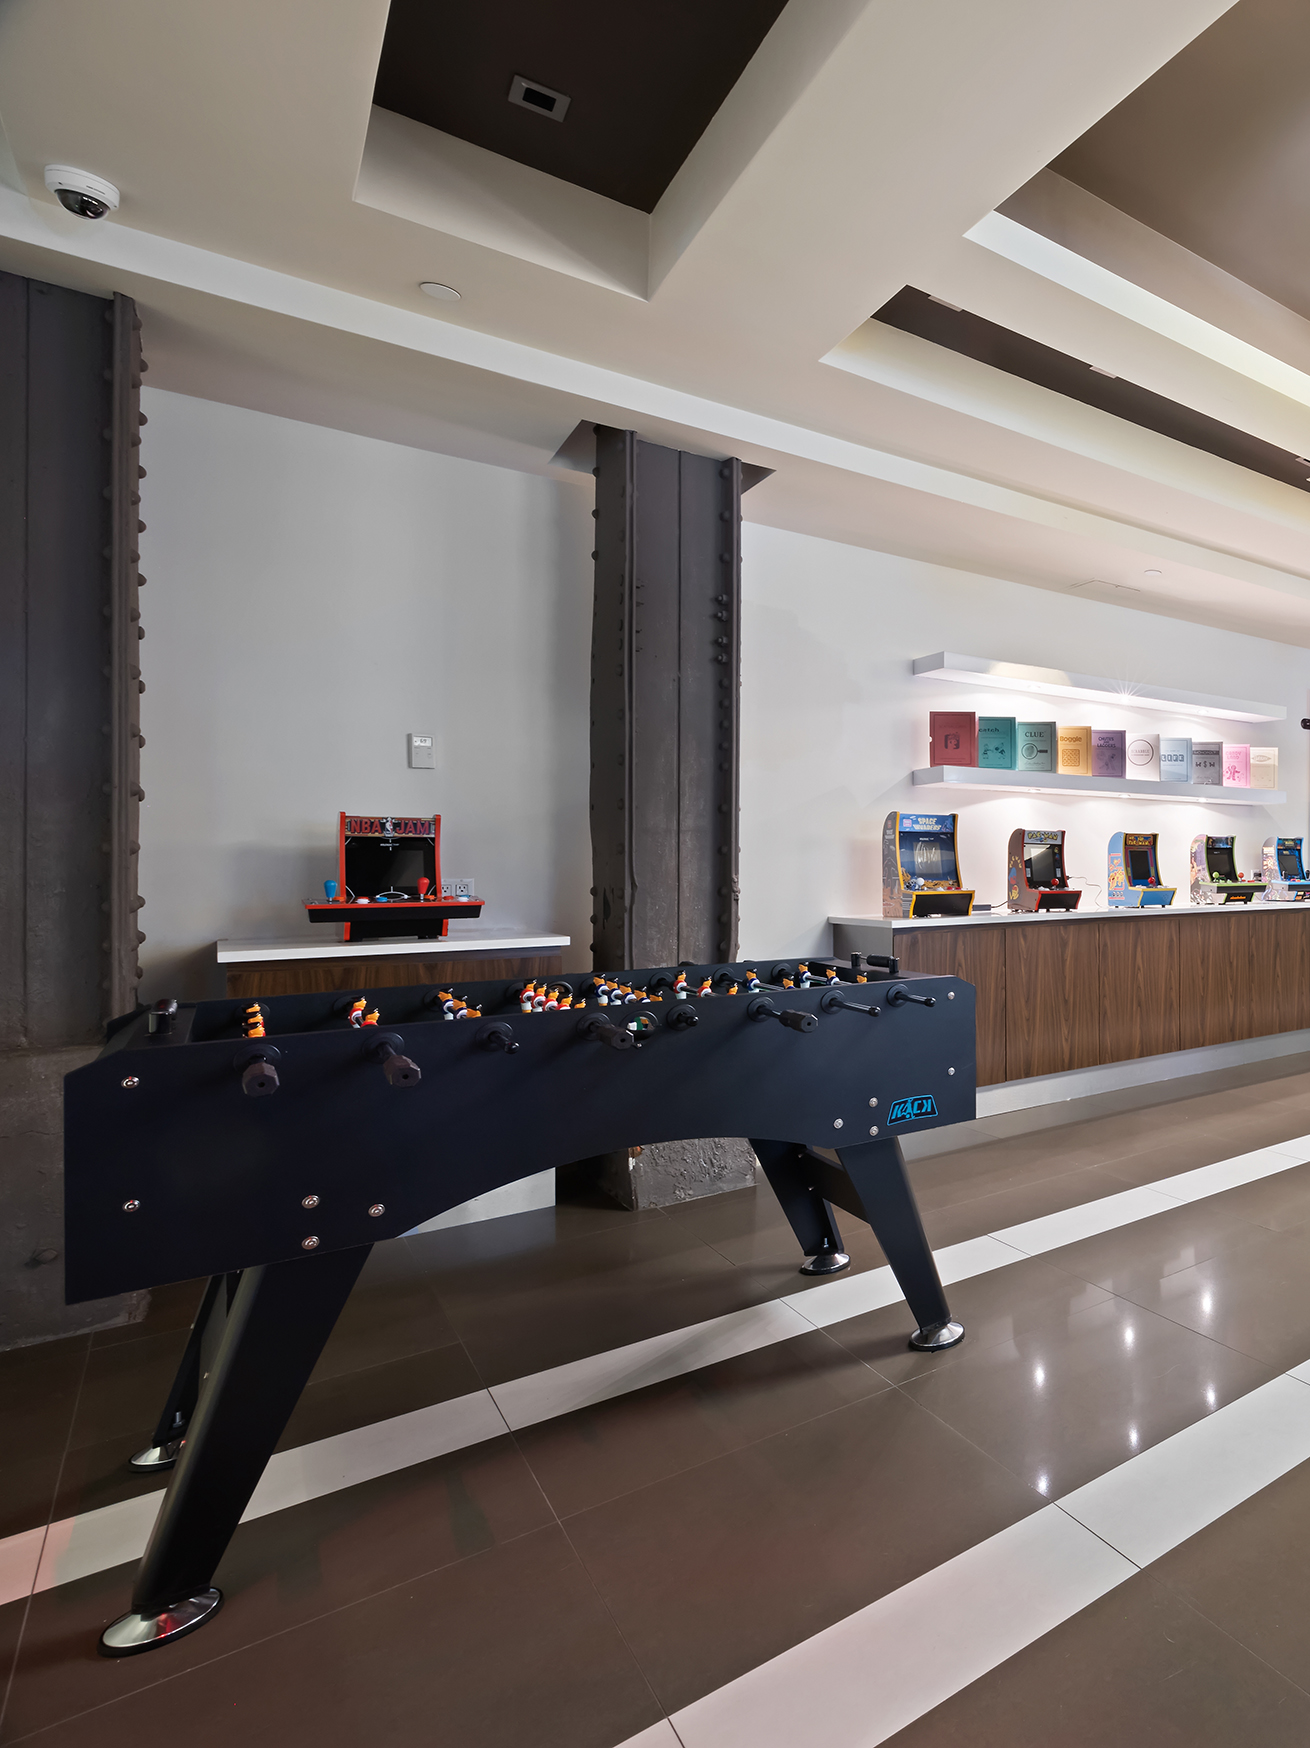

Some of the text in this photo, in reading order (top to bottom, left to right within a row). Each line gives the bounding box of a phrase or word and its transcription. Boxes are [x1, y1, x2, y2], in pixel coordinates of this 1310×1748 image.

[917, 817, 938, 825] SPACE
[349, 818, 430, 835] NBA JAM
[1027, 831, 1059, 841] PAC-MAN
